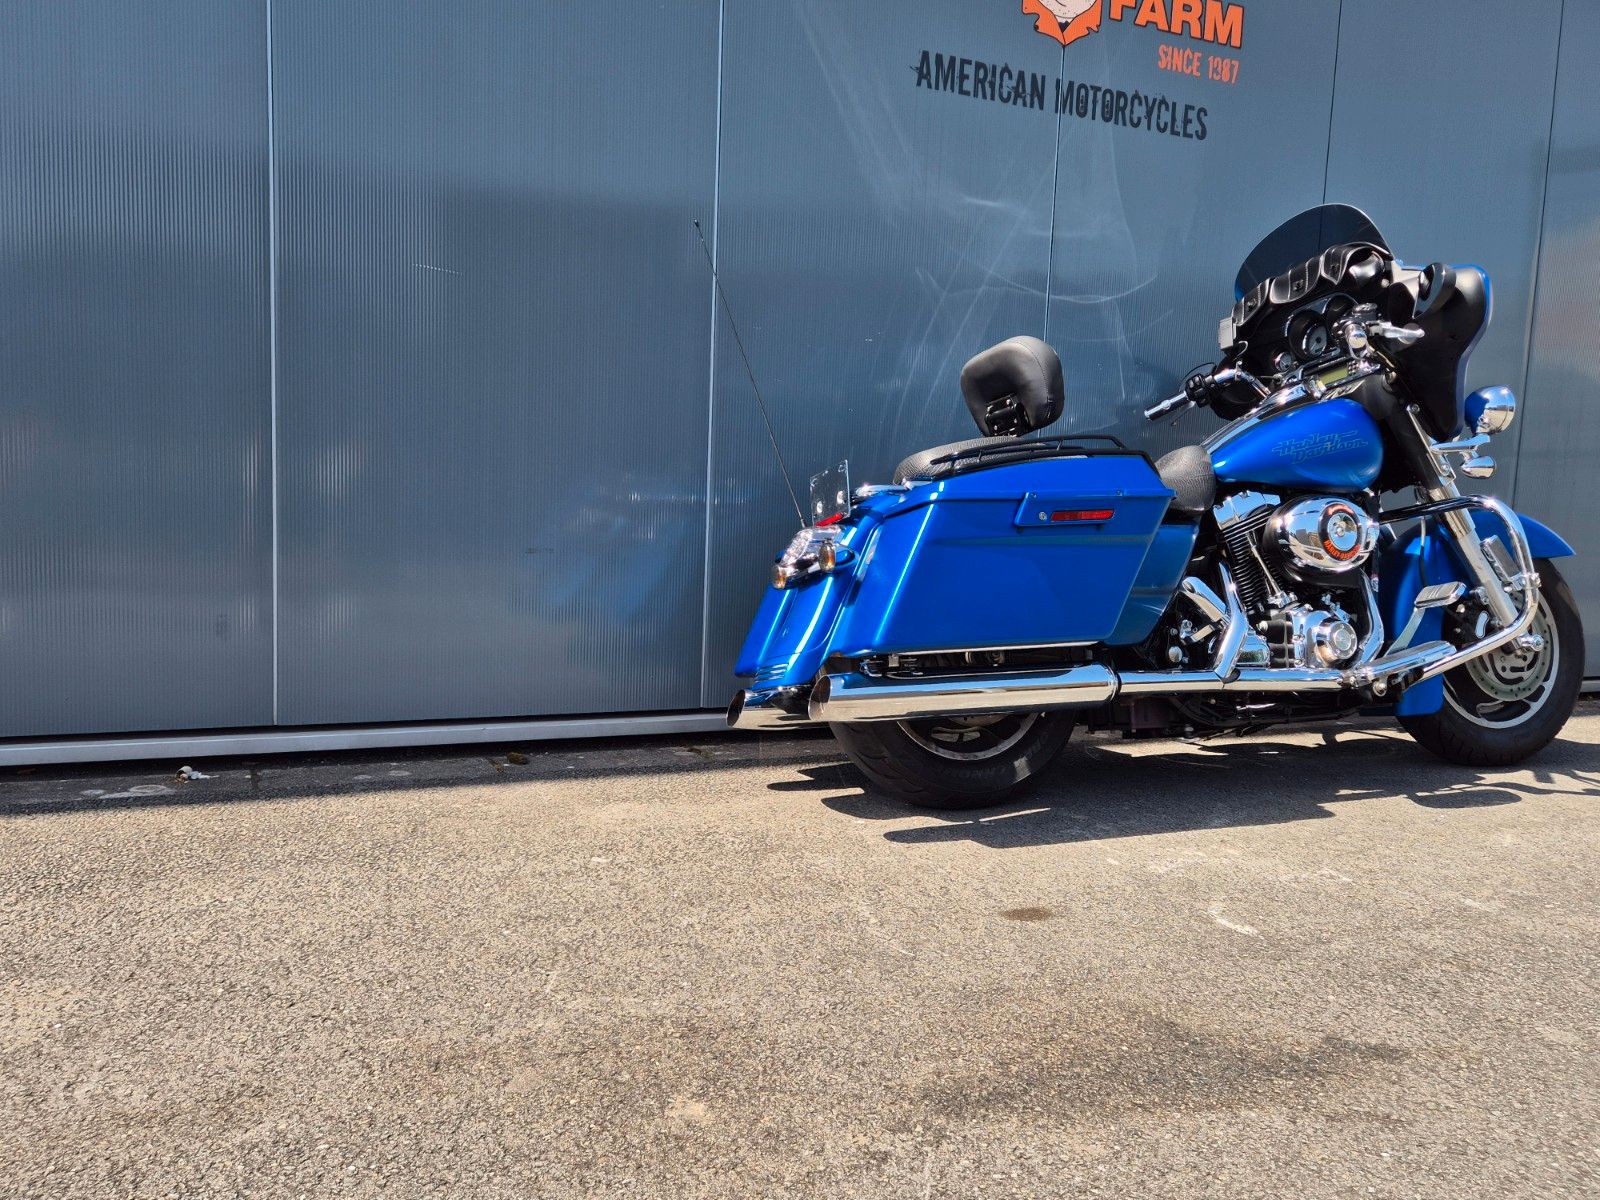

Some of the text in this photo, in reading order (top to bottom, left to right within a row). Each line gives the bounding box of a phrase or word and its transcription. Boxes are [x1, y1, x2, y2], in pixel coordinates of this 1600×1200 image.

[1158, 44, 1202, 78] SINCE
[911, 50, 1208, 141] AMERICAN MOTORCYCLES
